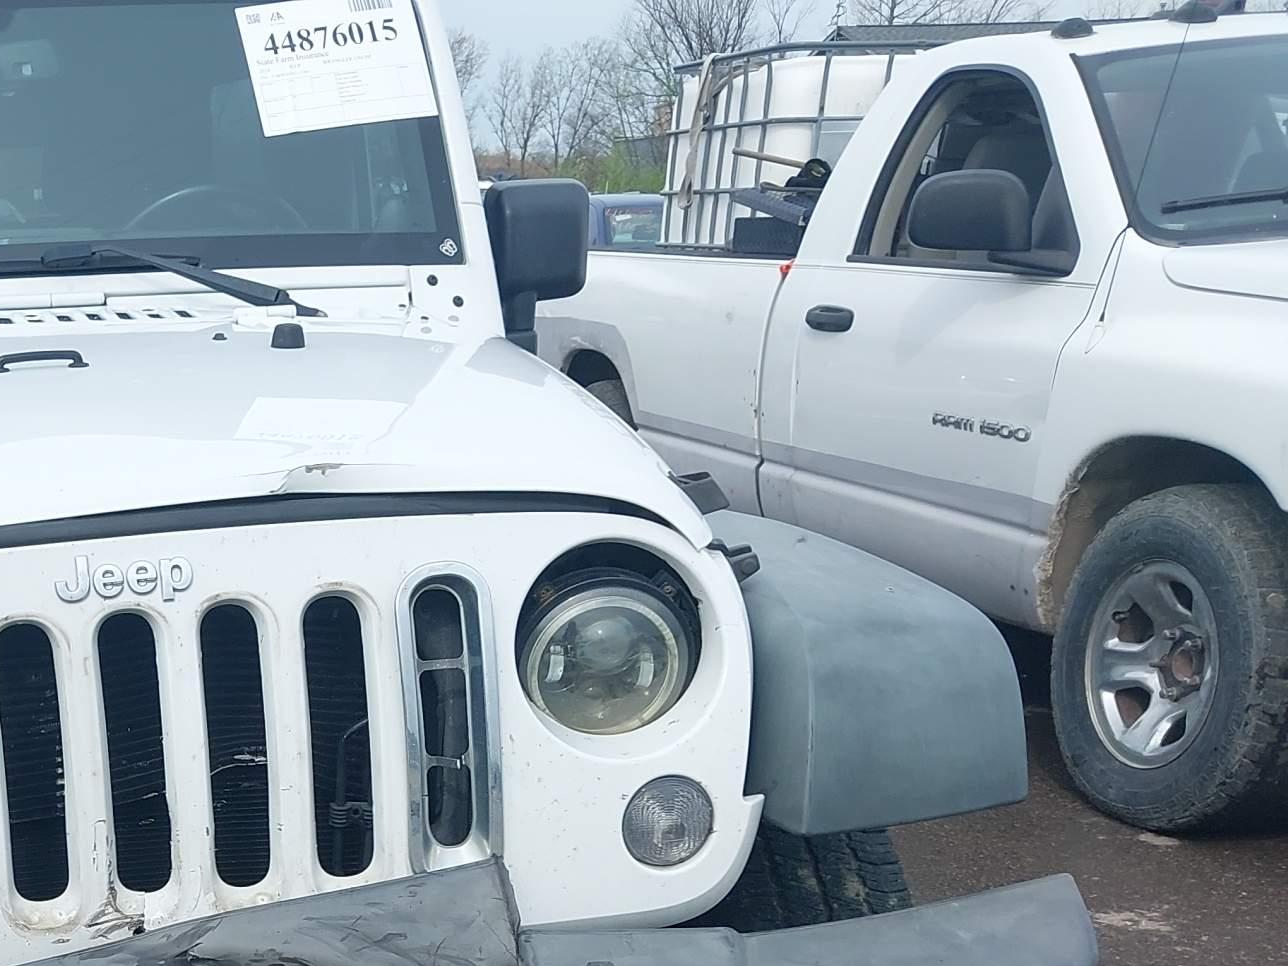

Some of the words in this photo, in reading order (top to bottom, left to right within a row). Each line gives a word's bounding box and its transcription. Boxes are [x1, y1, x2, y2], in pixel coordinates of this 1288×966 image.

[264, 18, 398, 54] 44876015
[932, 413, 974, 432] RAM
[979, 420, 1031, 442] 1500
[54, 555, 193, 603] Jeep
